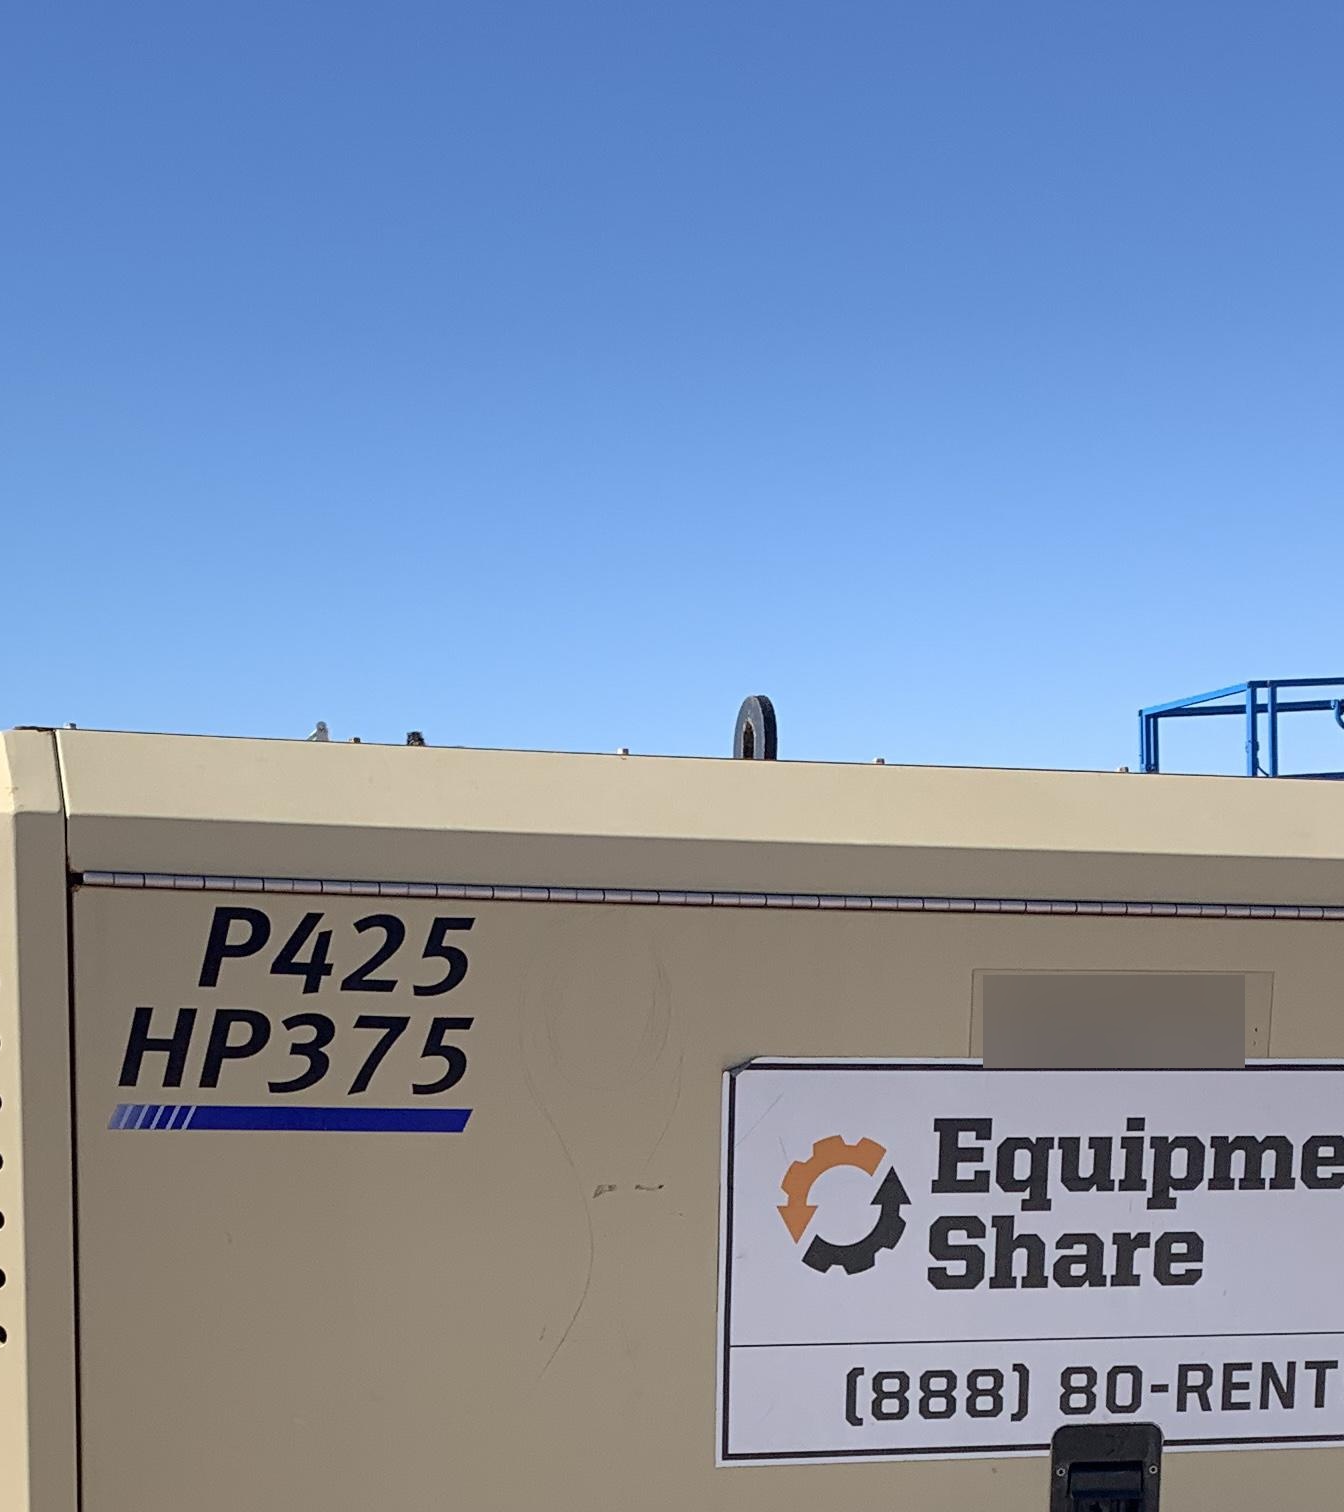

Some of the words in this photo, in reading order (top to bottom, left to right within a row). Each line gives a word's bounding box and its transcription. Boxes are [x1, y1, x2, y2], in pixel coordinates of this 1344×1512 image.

[198, 906, 476, 997] P425
[118, 1007, 475, 1096] HP375
[926, 1214, 1205, 1291] Share
[845, 1362, 1030, 1426] (888)
